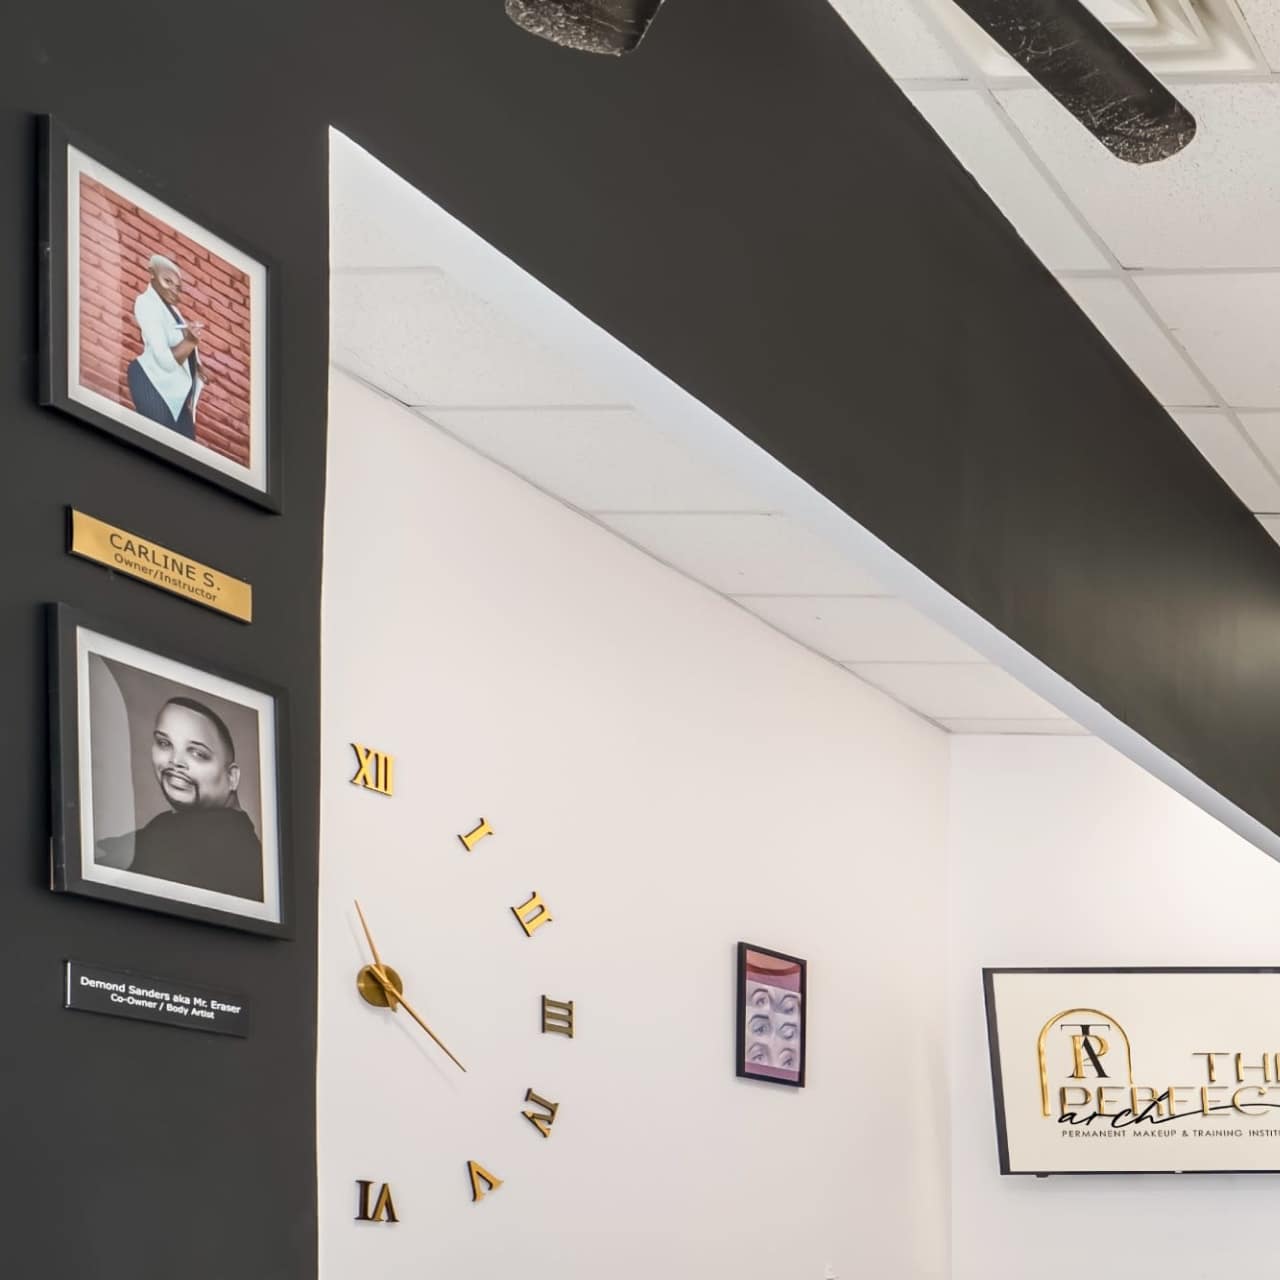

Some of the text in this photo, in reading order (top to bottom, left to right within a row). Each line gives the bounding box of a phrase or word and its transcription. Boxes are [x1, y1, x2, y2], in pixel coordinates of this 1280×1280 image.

[109, 533, 221, 591] CARLINE S.
[114, 553, 217, 602] Owner/Instructor
[350, 743, 395, 797] XII
[80, 976, 242, 1014] Demond Sanders aka Mr. Eraser
[110, 993, 157, 1010] Co-Owner
[166, 1003, 189, 1016] Body
[191, 1007, 215, 1019] Artist
[541, 995, 574, 1038] III
[1062, 1129, 1126, 1138] PERMANENT
[1133, 1129, 1177, 1138] MAKEUP
[1182, 1129, 1189, 1137] &
[1193, 1129, 1243, 1137] TRAINING
